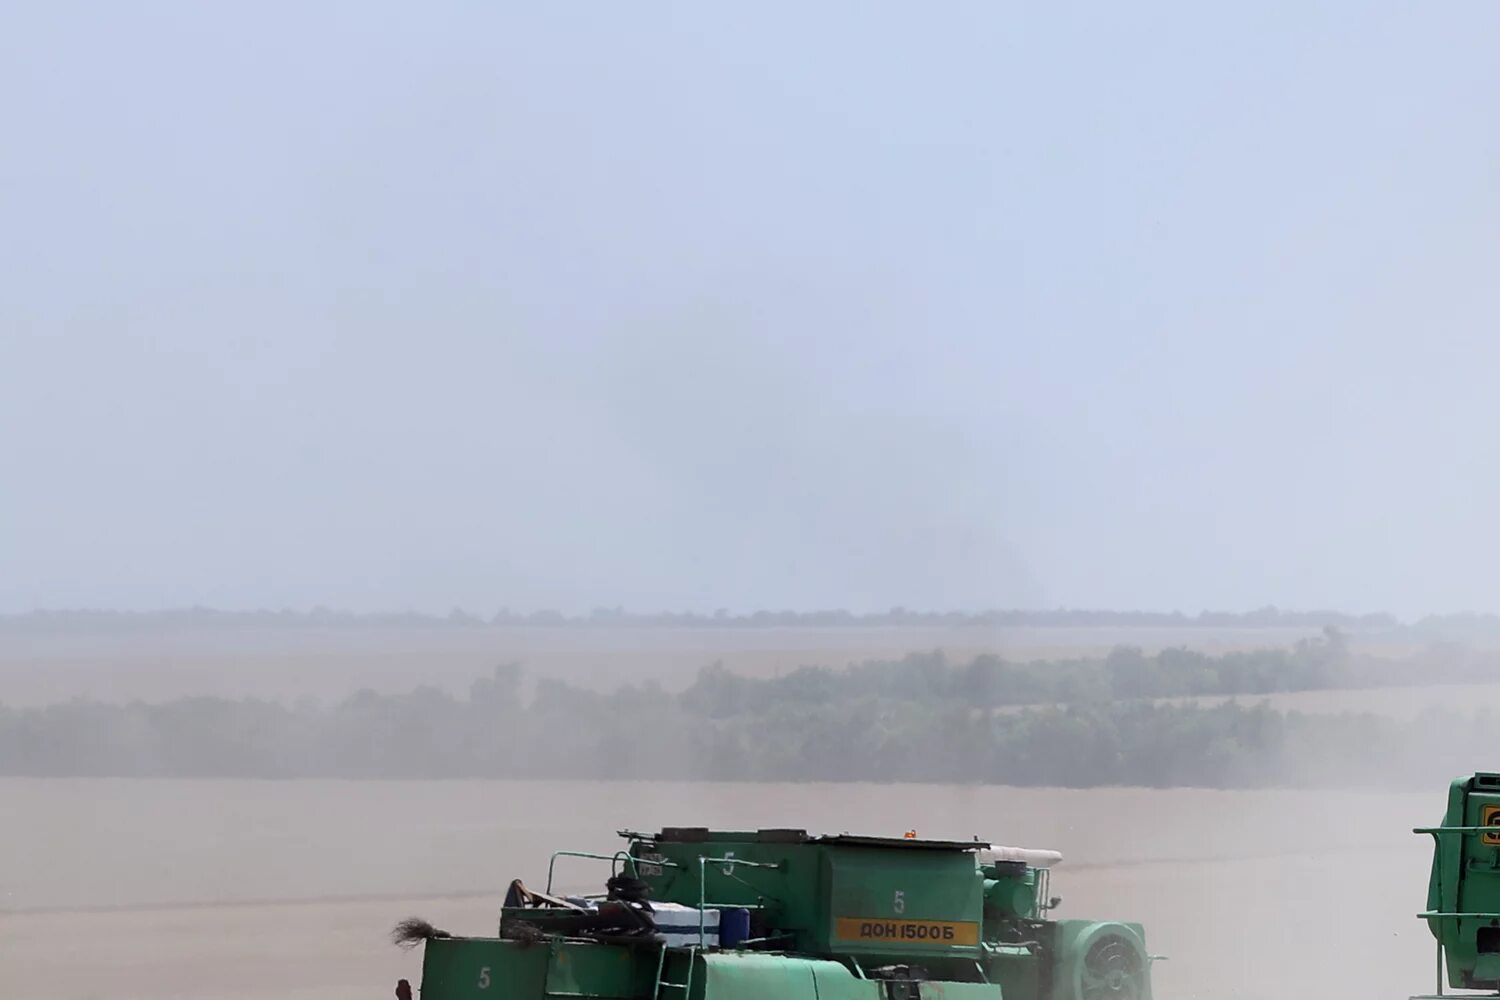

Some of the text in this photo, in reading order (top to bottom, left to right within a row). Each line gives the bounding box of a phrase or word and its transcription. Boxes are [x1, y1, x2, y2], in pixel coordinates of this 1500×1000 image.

[722, 851, 735, 876] 5
[894, 890, 905, 914] 5
[860, 922, 897, 938] ДОН
[478, 966, 491, 989] 5
